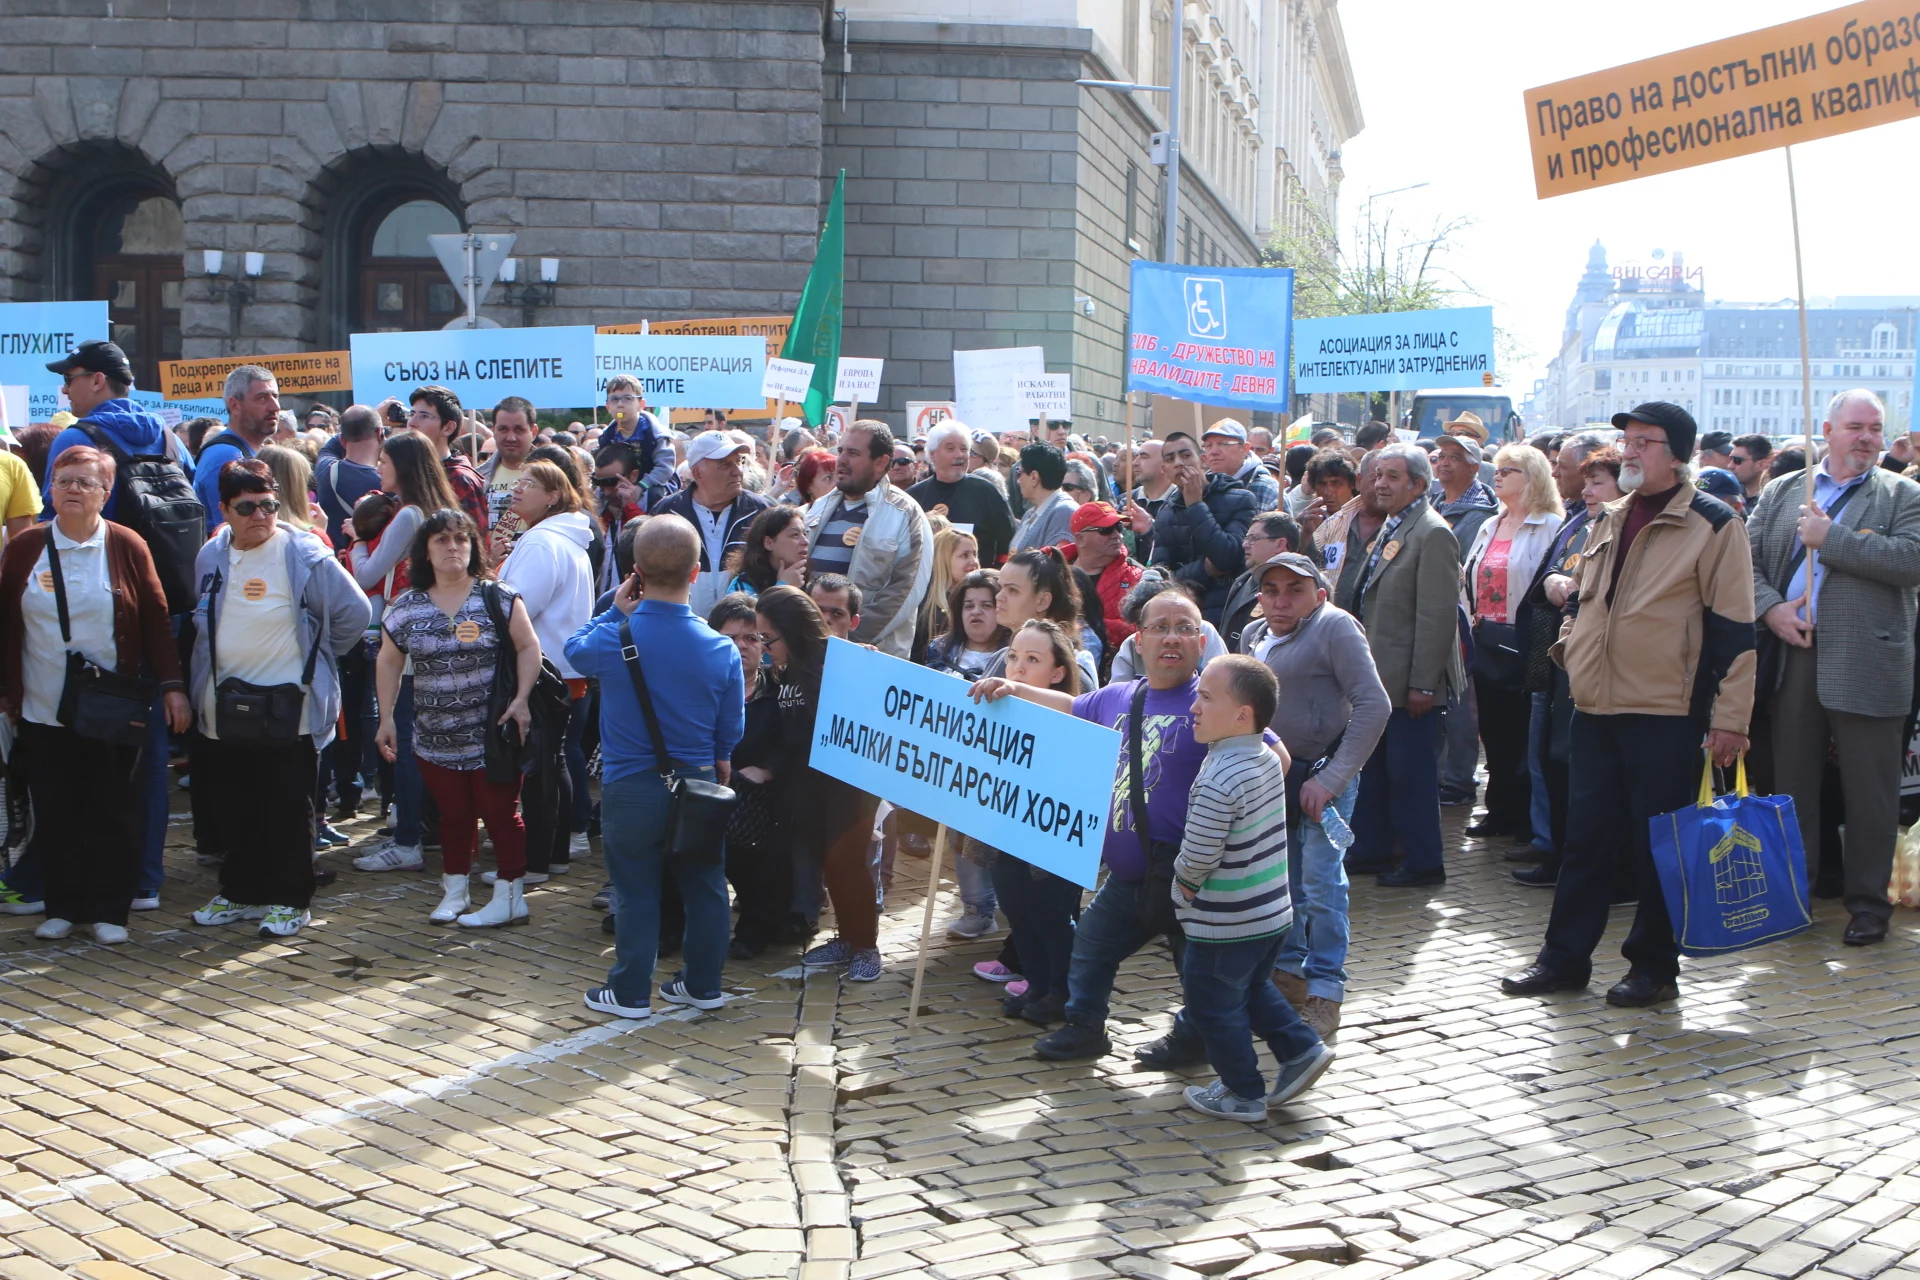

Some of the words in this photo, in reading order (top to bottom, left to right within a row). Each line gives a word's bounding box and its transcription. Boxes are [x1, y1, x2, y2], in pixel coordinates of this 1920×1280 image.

[1536, 91, 1622, 141] Право
[1630, 80, 1664, 114] на
[1671, 41, 1817, 111] достъпни
[1547, 152, 1564, 181] и
[1571, 96, 1803, 181] професионална
[1612, 266, 1703, 280] BULGARIA
[1, 333, 74, 354] ГЛУХИТЕ
[1171, 342, 1255, 367] ДРУЖЕСТВО
[1258, 350, 1276, 368] НА
[1319, 335, 1391, 356] АСОЦИАЦИЯ
[1395, 334, 1410, 350] ЗА
[1413, 332, 1447, 351] ЛИЦА
[1450, 331, 1458, 347] С
[325, 357, 340, 368] на
[384, 361, 439, 382] СЪЮЗ
[446, 360, 470, 380] НА
[476, 358, 563, 379] СЛЕПИТЕ
[596, 356, 643, 371] ТЕЛНА
[648, 356, 752, 375] КООПЕРАЦИЯ
[843, 369, 873, 378] ЕВРОПА
[1299, 358, 1395, 377] ИНТЕЛЕКТУАЛНИ
[1398, 354, 1487, 375] ЗАТРУДНЕНИЯ
[171, 382, 202, 396] деца
[205, 382, 213, 391] и
[278, 371, 342, 389] реждания!
[1017, 381, 1056, 389] ИСКАМЕ
[1131, 358, 1222, 390] НВАЛИДИТЕ
[1230, 374, 1276, 396] ДЕВНЯ
[1025, 391, 1066, 399] РАБОТНИ
[1033, 402, 1066, 410] МЕСТА!
[884, 685, 1036, 769] ОРГАНИЗАЦИЯ
[895, 740, 1020, 819] БЪЛГАРСКИ
